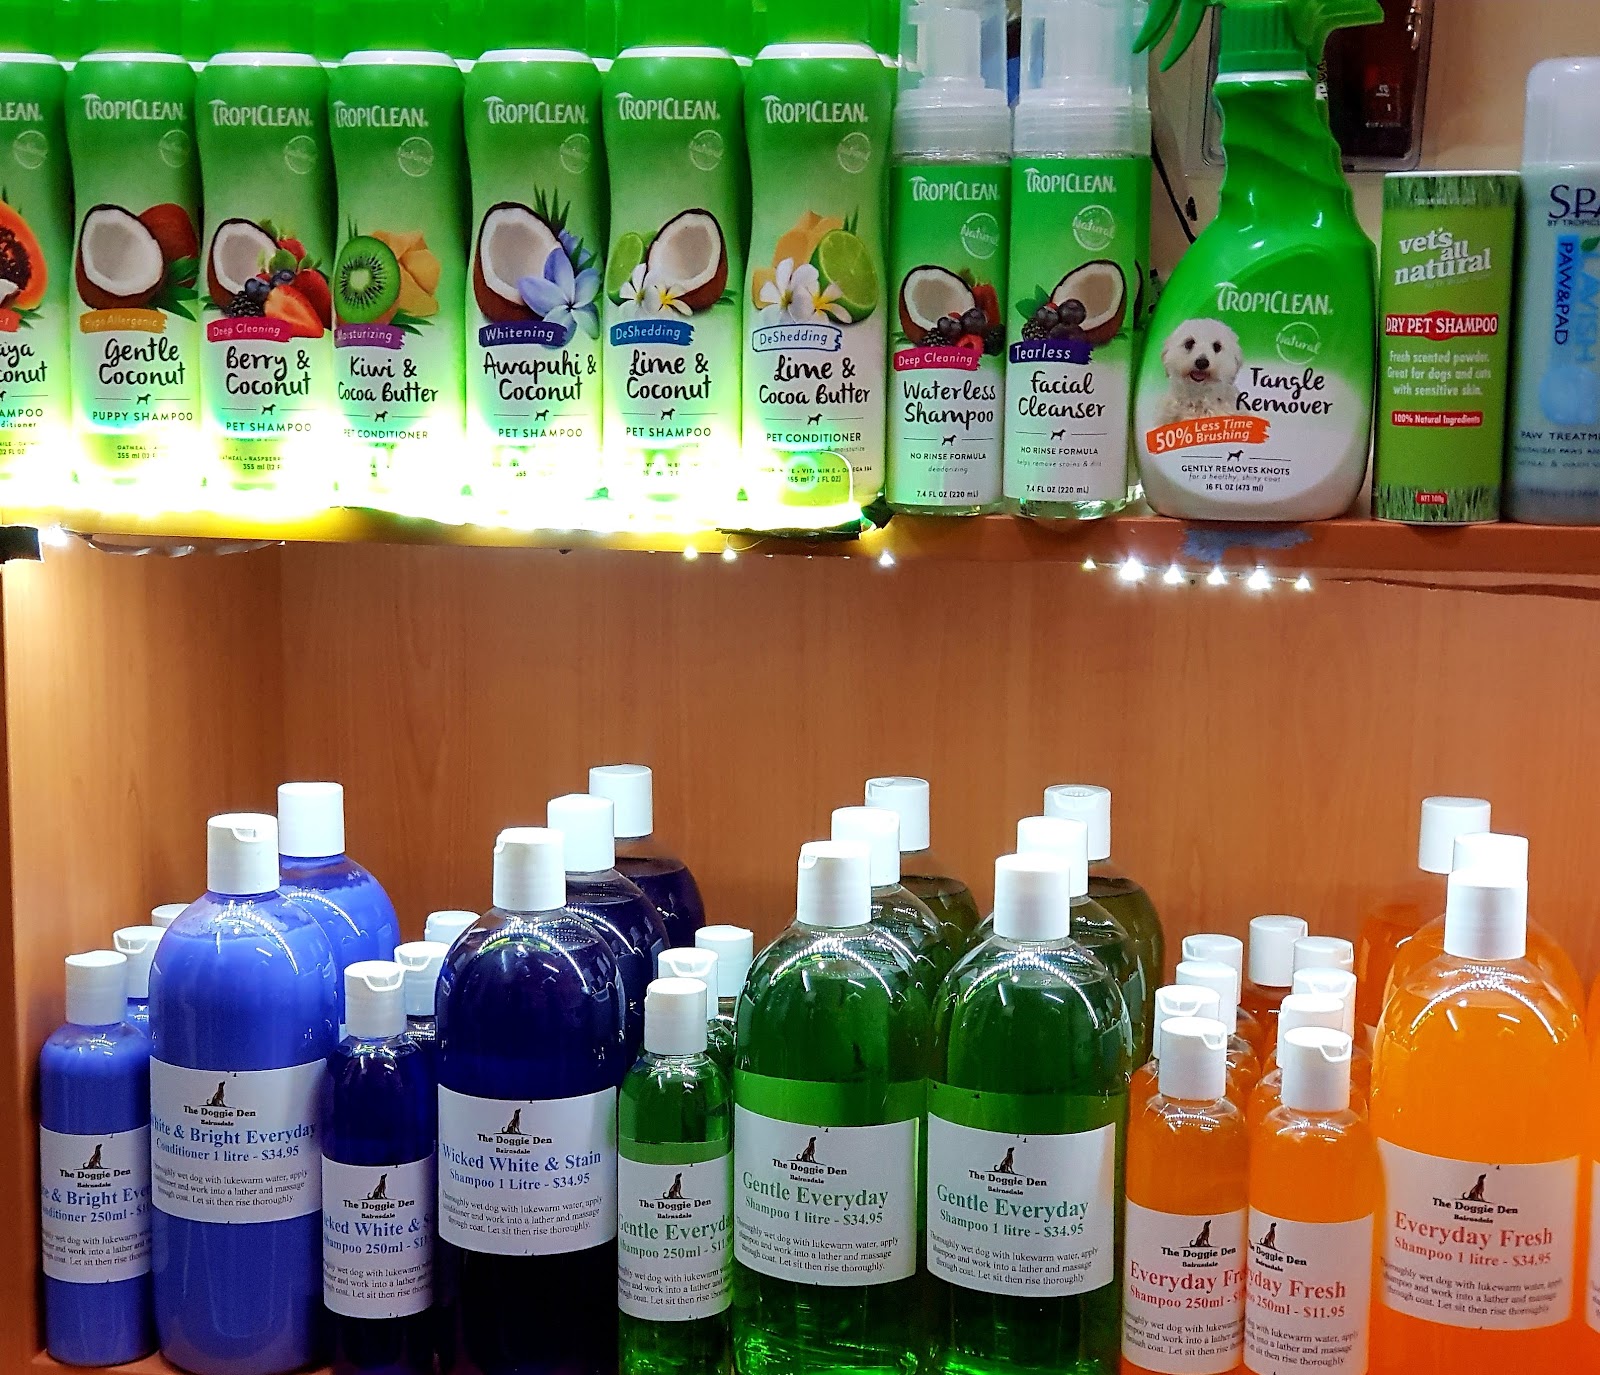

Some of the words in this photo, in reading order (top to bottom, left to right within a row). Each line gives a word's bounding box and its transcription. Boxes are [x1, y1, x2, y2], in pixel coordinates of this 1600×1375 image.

[81, 93, 184, 120] TROPICLEAN
[208, 100, 310, 126] TROPICLEAN
[333, 100, 423, 127] TROPICLEAN
[483, 96, 585, 124] TROPICLEAN
[615, 92, 716, 120] TROPICLEAN
[761, 95, 864, 123] TROPICLEAN
[908, 176, 998, 201] TROPICLEAN
[1024, 168, 1113, 192] TROPICLEAN
[1399, 227, 1452, 254] vet's
[1441, 241, 1468, 261] all
[1394, 248, 1491, 285] natural
[1215, 282, 1329, 315] TROPICLEAN
[1555, 242, 1573, 345] PAW&PAD
[213, 327, 232, 337] Deep
[236, 323, 280, 337] Cleaning
[486, 328, 554, 341] Whitening
[616, 326, 681, 341] DeShedding
[1387, 317, 1404, 332] DRY
[1407, 318, 1432, 333] PET
[1436, 317, 1498, 333] SHAMPOO
[760, 330, 827, 345] DeShedding
[105, 337, 179, 366] Gentle
[629, 350, 686, 375] Lime
[695, 353, 708, 373] &
[899, 355, 919, 367] Deep
[924, 353, 972, 365] Cleaning
[1015, 345, 1070, 360] Tearless
[99, 362, 185, 385] Coconut
[226, 346, 287, 381] Berry
[297, 350, 310, 368] &
[350, 356, 395, 378] Kiwi
[403, 359, 417, 377] &
[484, 350, 581, 384] Awapuhi
[588, 355, 597, 374] &
[774, 355, 832, 381] Lime
[842, 357, 855, 378] &
[1411, 367, 1424, 378] for
[1428, 367, 1451, 382] dogs
[1456, 367, 1472, 379] and
[226, 372, 311, 395] Coconut
[338, 382, 377, 401] Cocoa
[382, 382, 438, 402] Butter
[499, 377, 582, 401] Coconut
[626, 375, 712, 400] Coconut
[759, 385, 810, 404] Cocoa
[816, 383, 870, 404] Butter
[904, 380, 995, 400] Waterless
[1030, 371, 1094, 394] Facial
[1251, 368, 1324, 399] Tangle
[1394, 384, 1411, 395] with
[1415, 385, 1458, 395] sensitive
[1019, 397, 1105, 418] Cleanser
[1236, 392, 1333, 415] Remover
[92, 412, 128, 420] PUPPY
[134, 412, 192, 421] SHAMPOO
[226, 422, 244, 431] PET
[250, 423, 311, 431] SHAMPOO
[904, 403, 993, 430] Shampoo
[1195, 422, 1219, 433] Less
[1223, 419, 1253, 429] Time
[1394, 414, 1413, 422] 100%
[1415, 415, 1440, 423] Natural
[1443, 415, 1480, 425] Ingredients
[358, 429, 428, 439] CONDITIONER
[499, 428, 518, 437] PET
[523, 428, 582, 438] SHAMPOO
[626, 428, 643, 436] PET
[649, 428, 711, 437] SHAMPOO
[786, 433, 861, 442] CONDITIONER
[1156, 427, 1192, 450] 50%
[1197, 430, 1249, 443] Brushing
[1261, 467, 1290, 475] KNOTS
[183, 1105, 198, 1114] The
[201, 1108, 233, 1118] Doggie
[174, 1125, 185, 1138] &
[190, 1128, 240, 1147] Bright
[247, 1123, 316, 1144] Everyday
[477, 1134, 493, 1143] The
[496, 1136, 530, 1145] Doggie
[156, 1138, 209, 1160] Conditioner
[214, 1151, 218, 1160] 1
[224, 1151, 249, 1161] litre
[262, 1146, 299, 1161] $34.95
[442, 1143, 484, 1169] Wicked
[489, 1157, 539, 1172] White
[545, 1157, 559, 1171] &
[565, 1151, 601, 1169] Stain
[772, 1159, 788, 1169] The
[791, 1163, 824, 1175] Doggie
[828, 1167, 847, 1175] Den
[450, 1168, 494, 1188] Shampoo
[499, 1180, 503, 1188] 1
[510, 1180, 540, 1190] Litre
[553, 1172, 590, 1189] $34.95
[67, 1191, 117, 1209] Bright
[743, 1172, 790, 1201] Gentle
[797, 1186, 888, 1210] Everyday
[745, 1196, 790, 1219] Shampoo
[794, 1211, 799, 1221] 1
[805, 1212, 830, 1225] litre
[843, 1213, 883, 1225] $34.95
[937, 1184, 988, 1212] Gentle
[995, 1198, 1089, 1222] Everyday
[90, 1209, 127, 1223] 250ml
[940, 1209, 988, 1232] Shampoo
[994, 1223, 998, 1233] 1
[1004, 1225, 1030, 1237] litre
[1044, 1224, 1084, 1238] $34.95
[355, 1222, 403, 1236] White
[1396, 1211, 1492, 1250] Everyday
[1500, 1227, 1553, 1247] Fresh
[366, 1242, 403, 1254] 250ml
[663, 1246, 700, 1258] 250ml
[1012, 1252, 1054, 1262] lukewarm
[1394, 1236, 1452, 1261] Shampoo
[1458, 1252, 1463, 1262] 1
[1470, 1253, 1498, 1266] litre
[1512, 1252, 1551, 1267] $34.95
[1019, 1263, 1042, 1272] lather
[1131, 1260, 1217, 1294] Everyday
[1130, 1285, 1181, 1308] Shampoo
[1186, 1297, 1223, 1308] 250ml
[1289, 1279, 1346, 1299] Fresh
[1257, 1295, 1290, 1315] 250ml
[1303, 1306, 1345, 1318] $11.95
